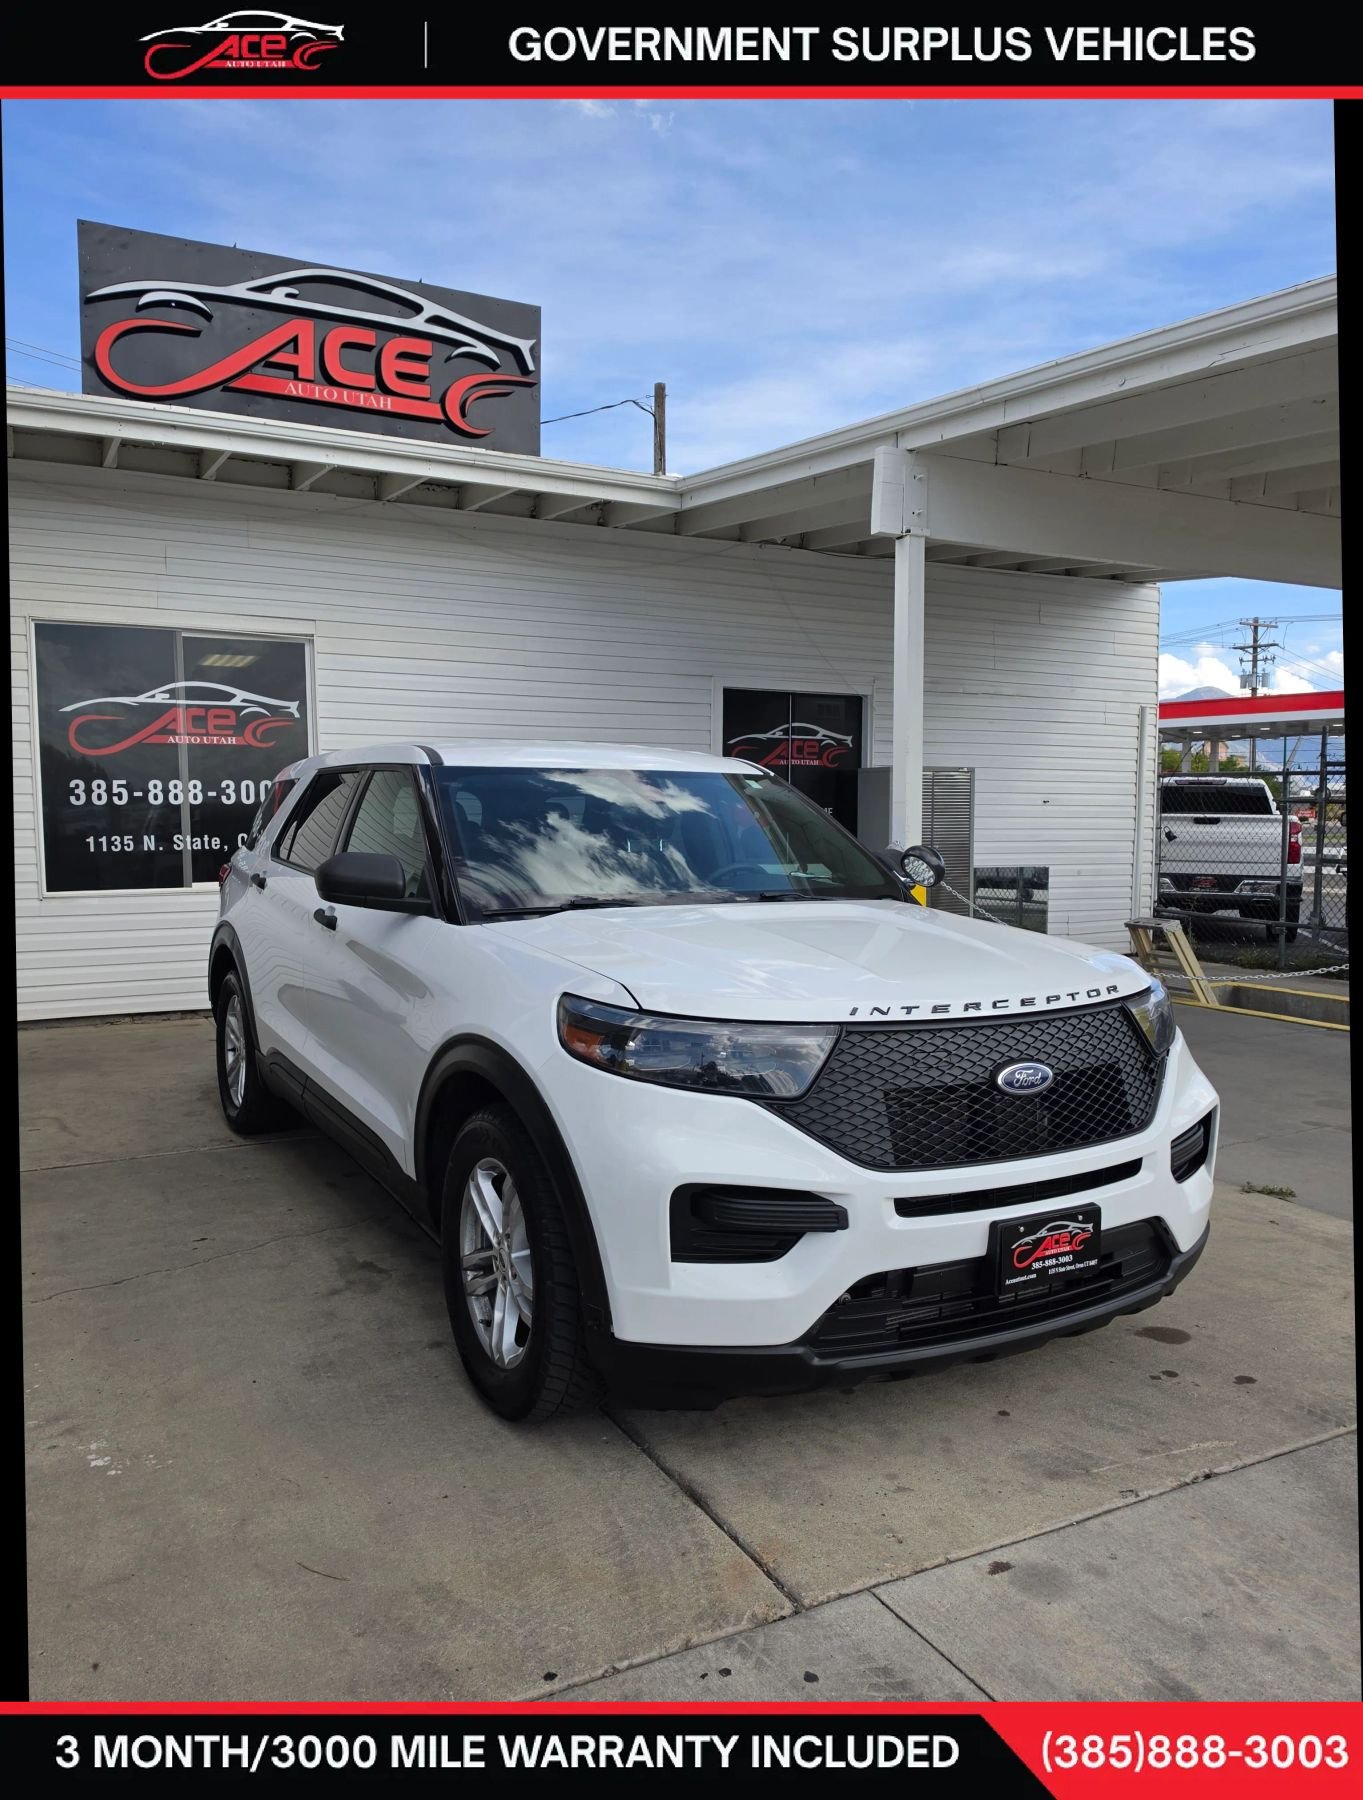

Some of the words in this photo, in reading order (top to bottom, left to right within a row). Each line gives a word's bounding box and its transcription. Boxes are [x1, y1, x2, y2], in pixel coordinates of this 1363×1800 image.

[235, 319, 433, 399] ACE
[284, 380, 339, 401] AUTO
[341, 388, 392, 410] UTAH
[167, 735, 200, 744] AUTO
[203, 736, 236, 745] UTAH
[69, 779, 272, 805] 385-888-300
[86, 835, 134, 852] 1135
[143, 834, 164, 851] N.
[173, 833, 228, 852] State,
[849, 984, 1120, 1016] INTERCEPTOR
[1012, 1069, 1043, 1088] Ford
